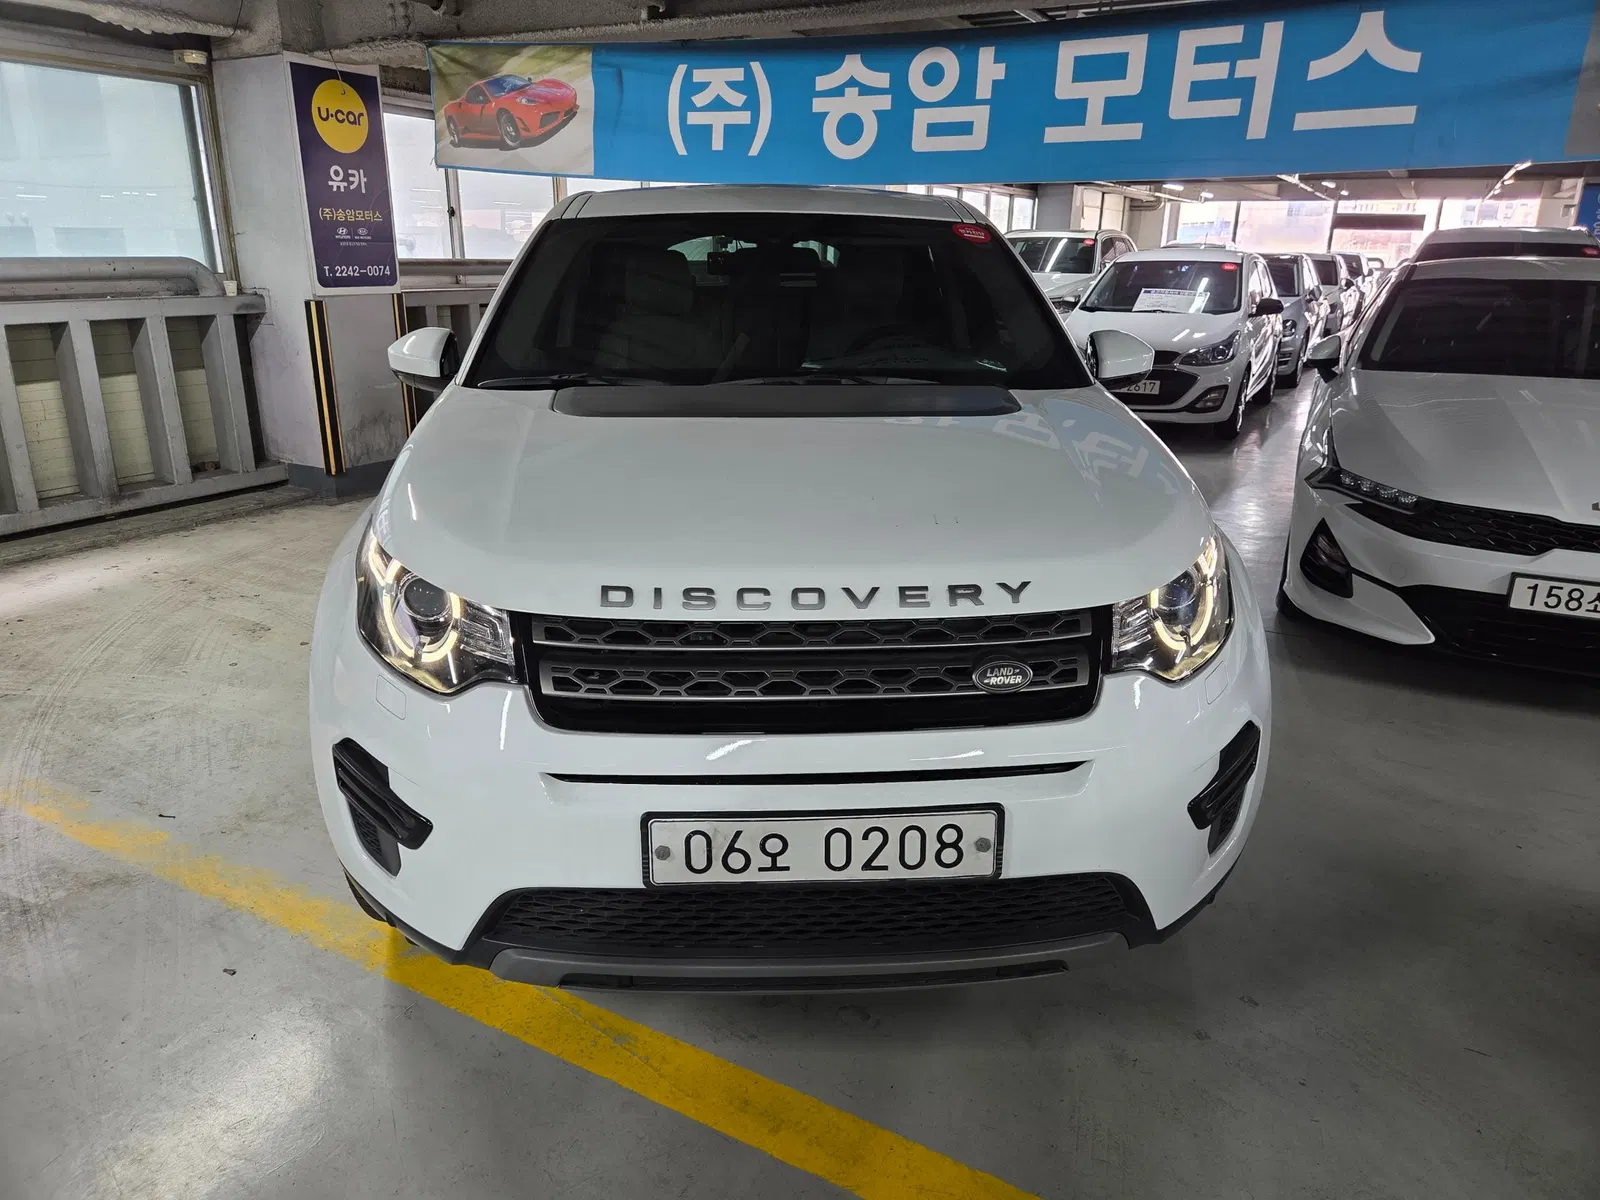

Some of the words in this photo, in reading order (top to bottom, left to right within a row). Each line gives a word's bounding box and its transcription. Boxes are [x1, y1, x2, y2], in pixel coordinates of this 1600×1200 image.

[668, 61, 772, 156] (주)
[812, 46, 1006, 160] 송암
[1043, 11, 1422, 143] 모터스
[328, 165, 367, 194] 유카
[318, 207, 383, 222] (주)송암모터스
[323, 266, 333, 277] T.
[334, 265, 391, 277] 2242-0074
[600, 581, 1031, 611] DISCOVERY
[986, 667, 1014, 677] LAND
[989, 675, 1023, 685] ROVER
[684, 829, 791, 875] 06오
[824, 823, 964, 872] 0208
